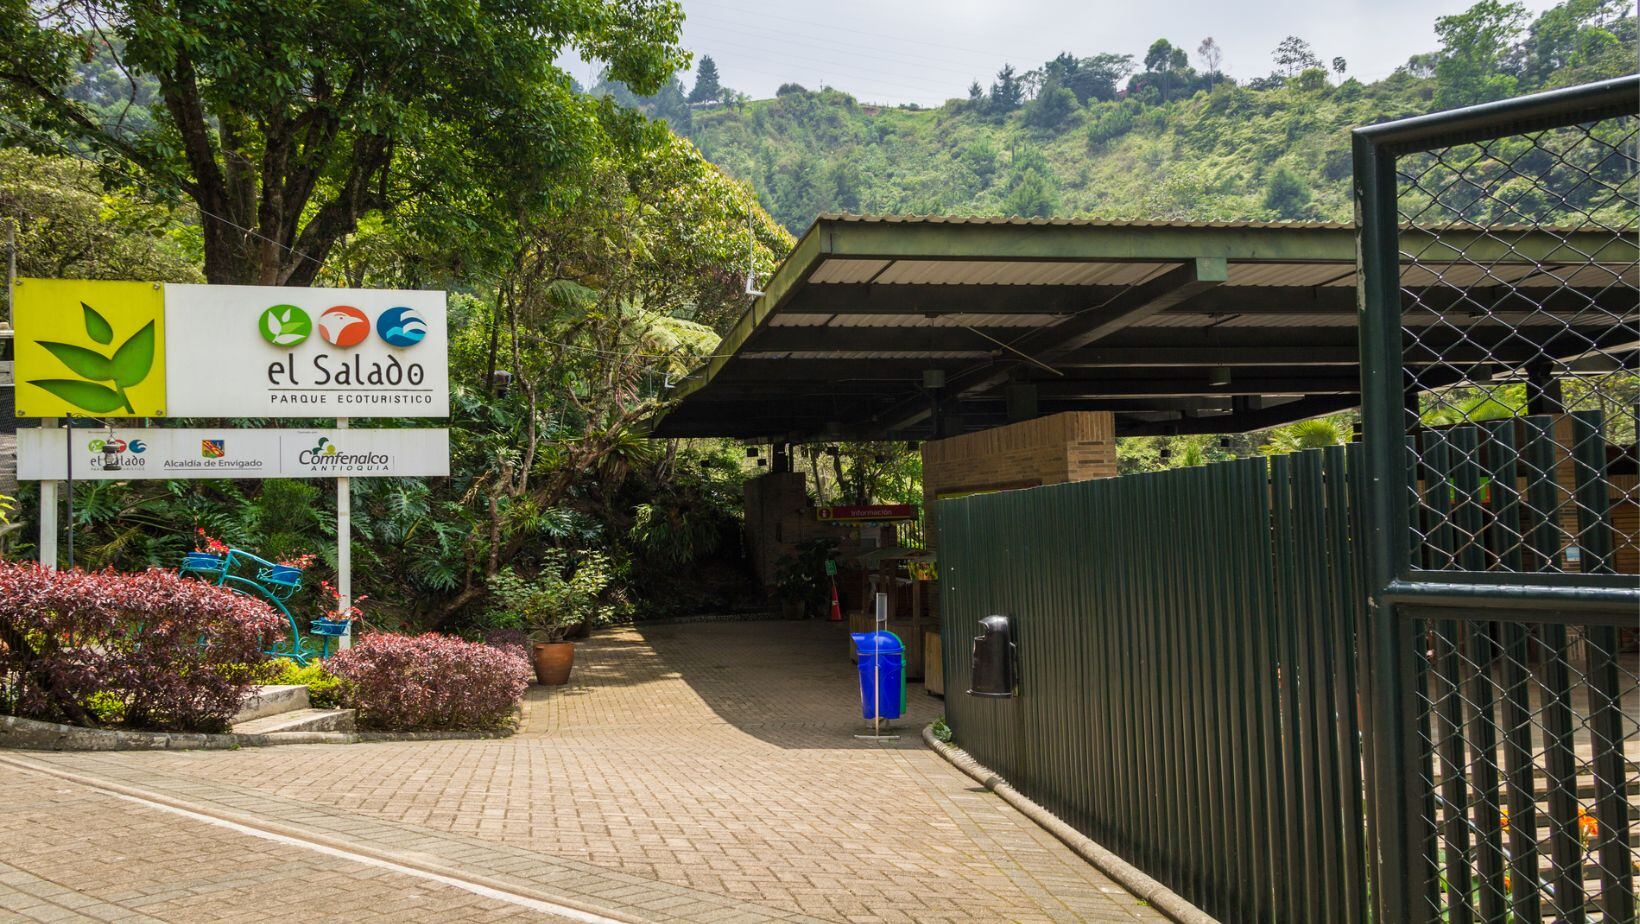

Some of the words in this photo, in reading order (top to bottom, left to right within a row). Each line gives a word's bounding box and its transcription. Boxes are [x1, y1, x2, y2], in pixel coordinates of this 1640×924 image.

[268, 353, 299, 385] el
[313, 353, 424, 386] Salado
[271, 394, 327, 404] PARQUE
[337, 394, 433, 404] ECOTURISTICO
[90, 455, 101, 466] el
[108, 455, 146, 466] alado
[298, 449, 389, 465] Comfenalco
[163, 459, 202, 468] Alcaldía
[204, 459, 216, 468] de
[218, 459, 263, 470] Envigado
